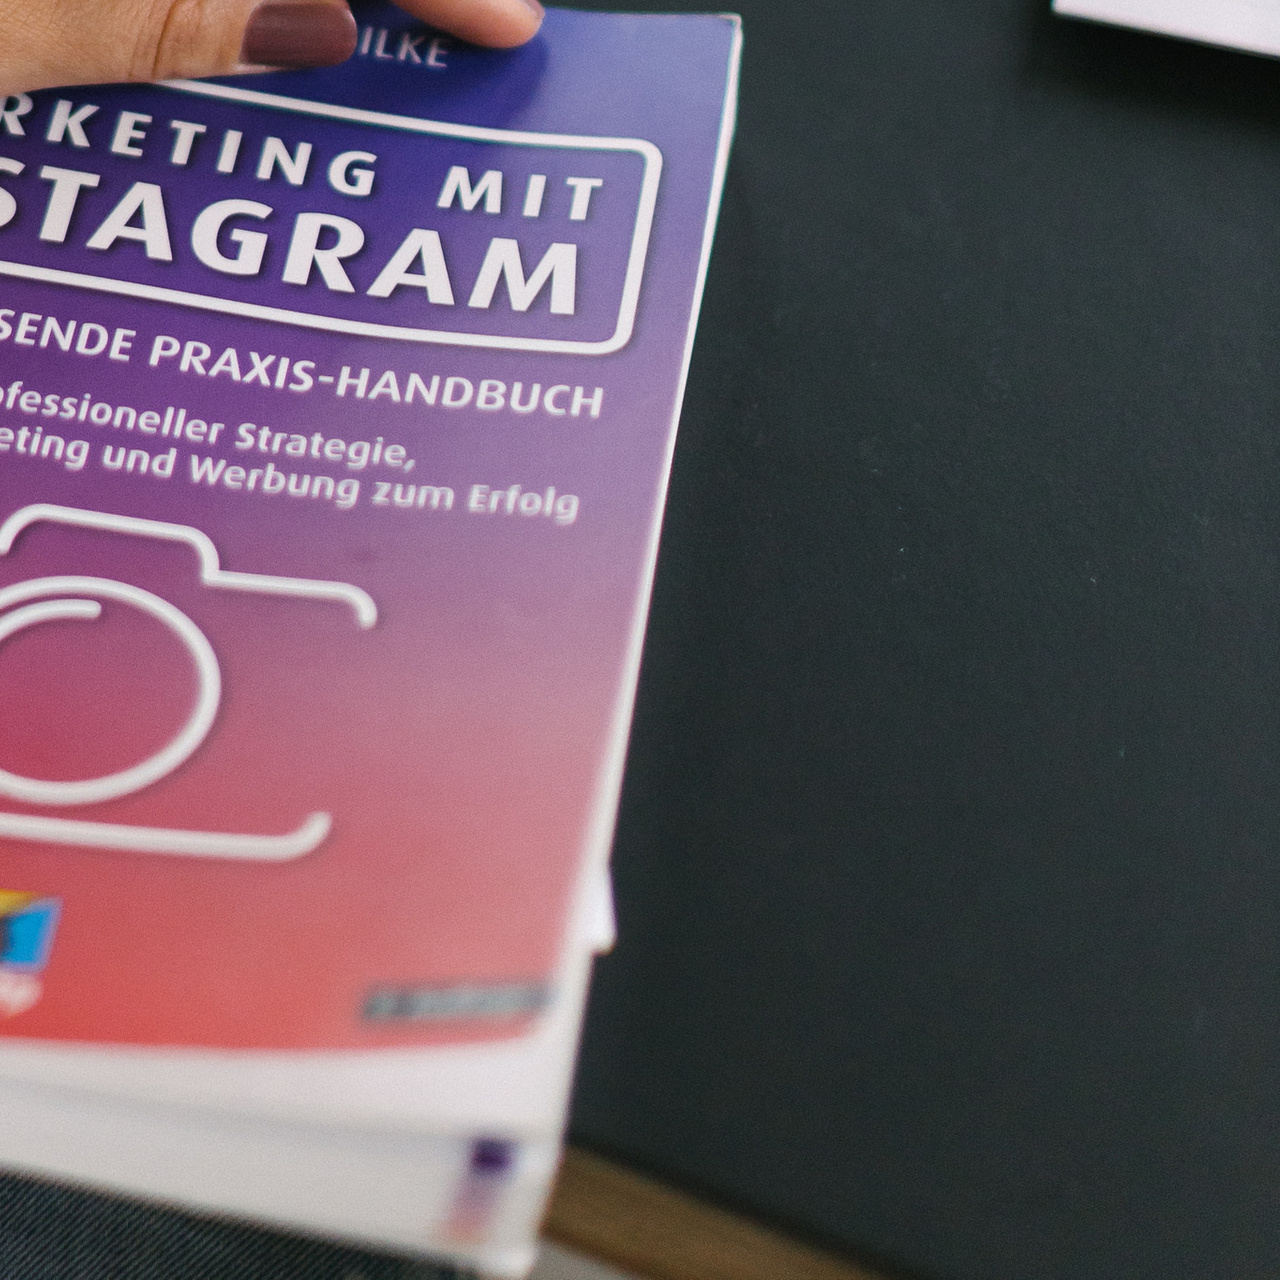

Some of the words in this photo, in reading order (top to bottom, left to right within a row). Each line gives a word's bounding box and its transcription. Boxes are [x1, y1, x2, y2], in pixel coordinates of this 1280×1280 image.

[358, 25, 449, 69] ILKE
[436, 165, 604, 221] MIT
[148, 334, 605, 419] PRAXIS-HANDBUCH
[234, 422, 417, 473] Strategie,
[102, 444, 178, 479] und
[190, 453, 360, 510] Werbung
[371, 480, 455, 512] zum
[467, 483, 581, 526] Erfolg
